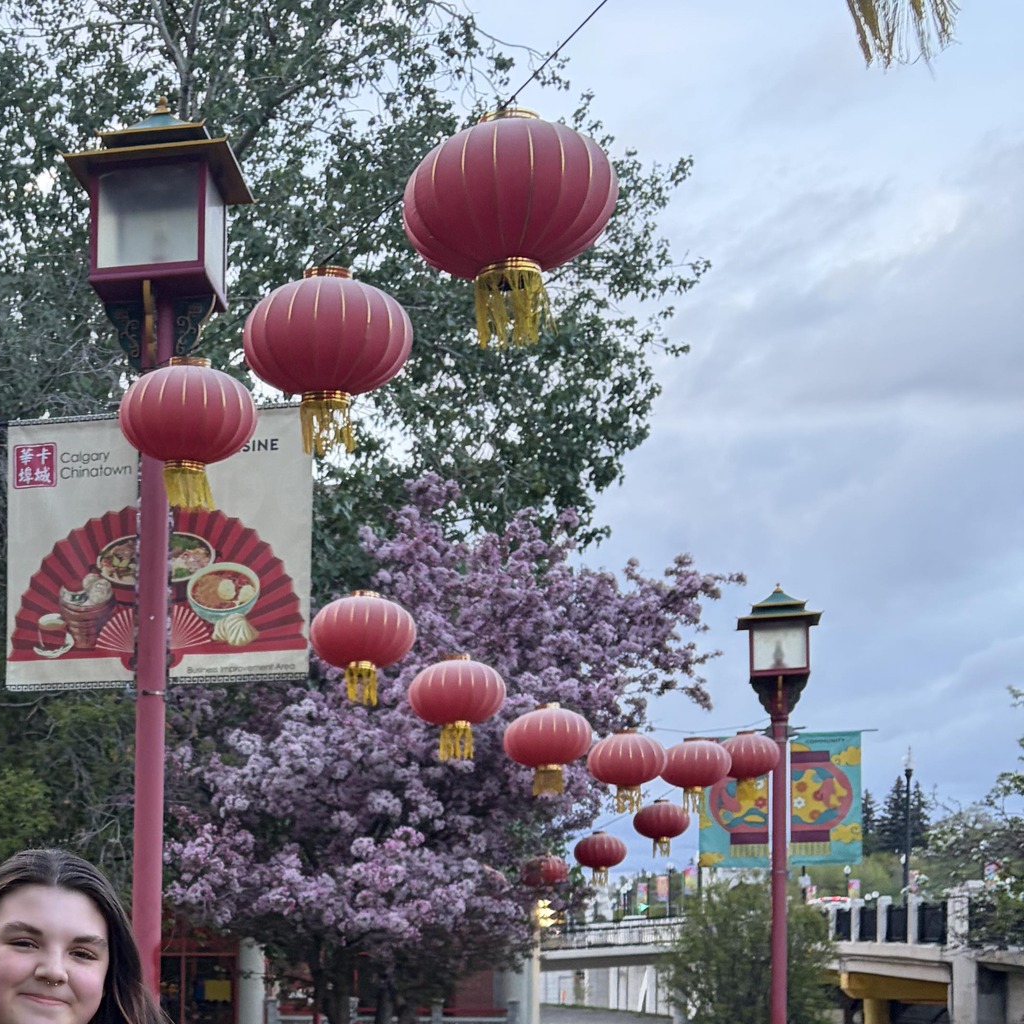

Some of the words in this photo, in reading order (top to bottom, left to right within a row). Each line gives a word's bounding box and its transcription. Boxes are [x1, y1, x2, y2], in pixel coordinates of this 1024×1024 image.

[240, 438, 279, 452] SINE
[60, 451, 110, 464] Calgary
[60, 465, 132, 479] Chinatown
[186, 666, 219, 674] Business
[220, 664, 274, 673] Improvement
[275, 663, 296, 671] Area
